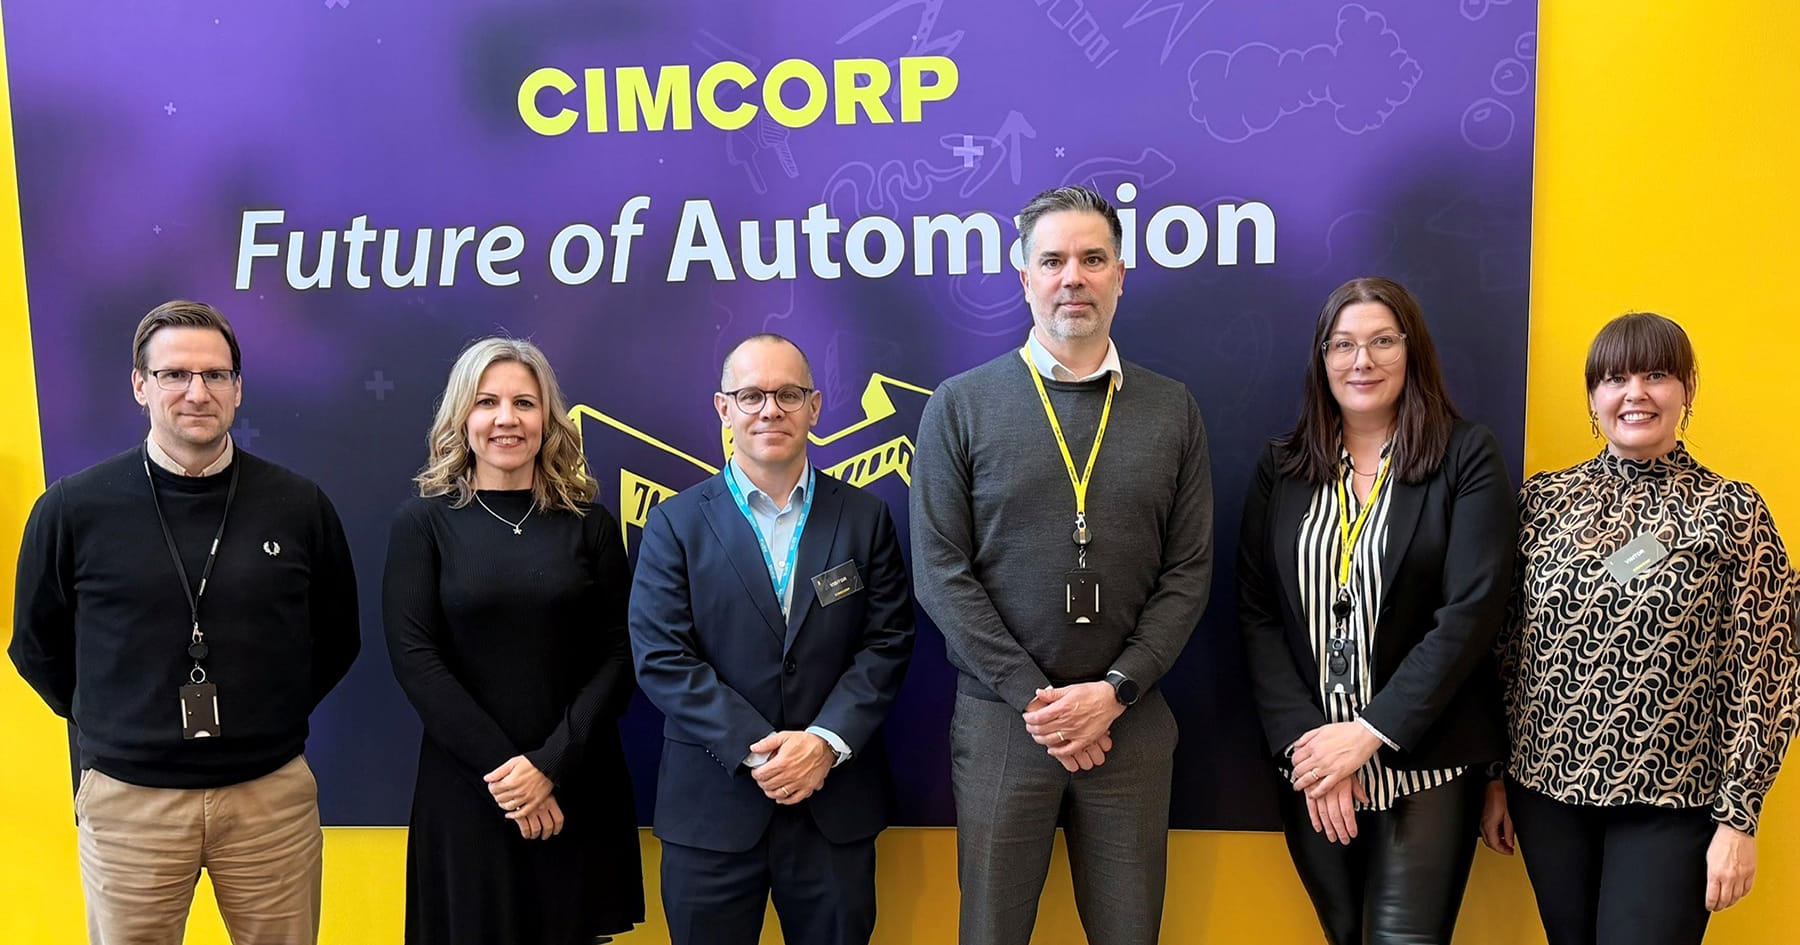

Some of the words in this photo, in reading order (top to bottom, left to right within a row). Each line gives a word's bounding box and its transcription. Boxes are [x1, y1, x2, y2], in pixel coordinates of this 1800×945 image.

[519, 57, 958, 134] CIMCORP
[235, 210, 525, 290] Future
[549, 195, 651, 285] of
[666, 182, 1276, 282] Automion
